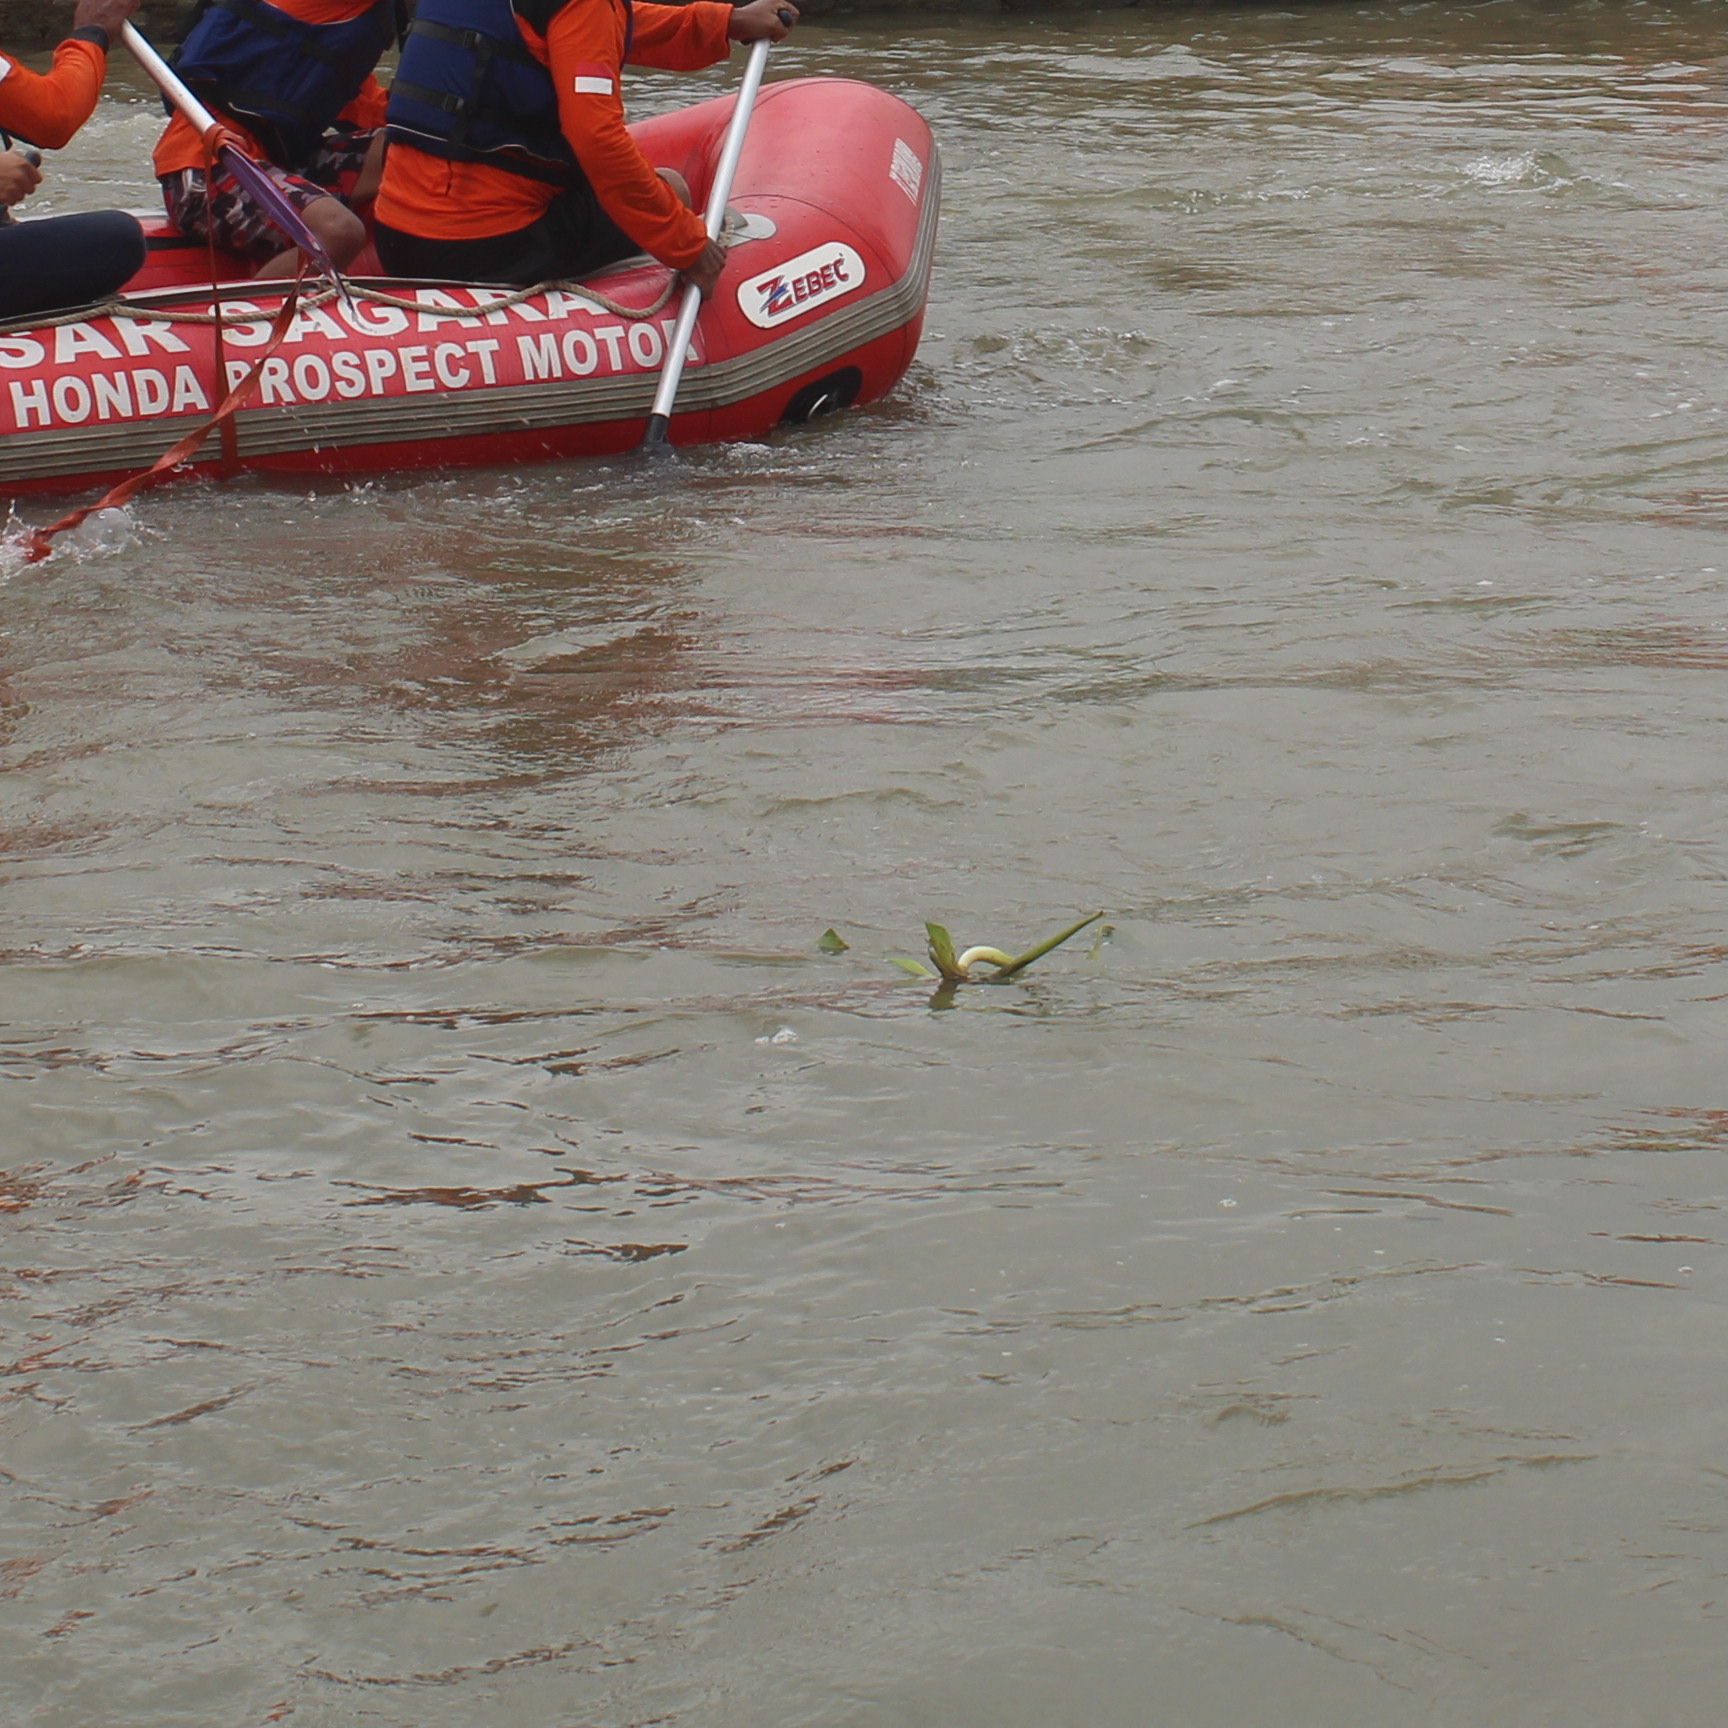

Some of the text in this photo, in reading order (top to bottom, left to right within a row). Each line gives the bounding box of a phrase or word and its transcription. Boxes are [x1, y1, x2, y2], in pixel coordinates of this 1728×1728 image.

[207, 288, 611, 348] SAGARA
[756, 257, 850, 318] ZEBEC
[8, 363, 210, 429] HONDA
[224, 338, 500, 405] PROSPECT
